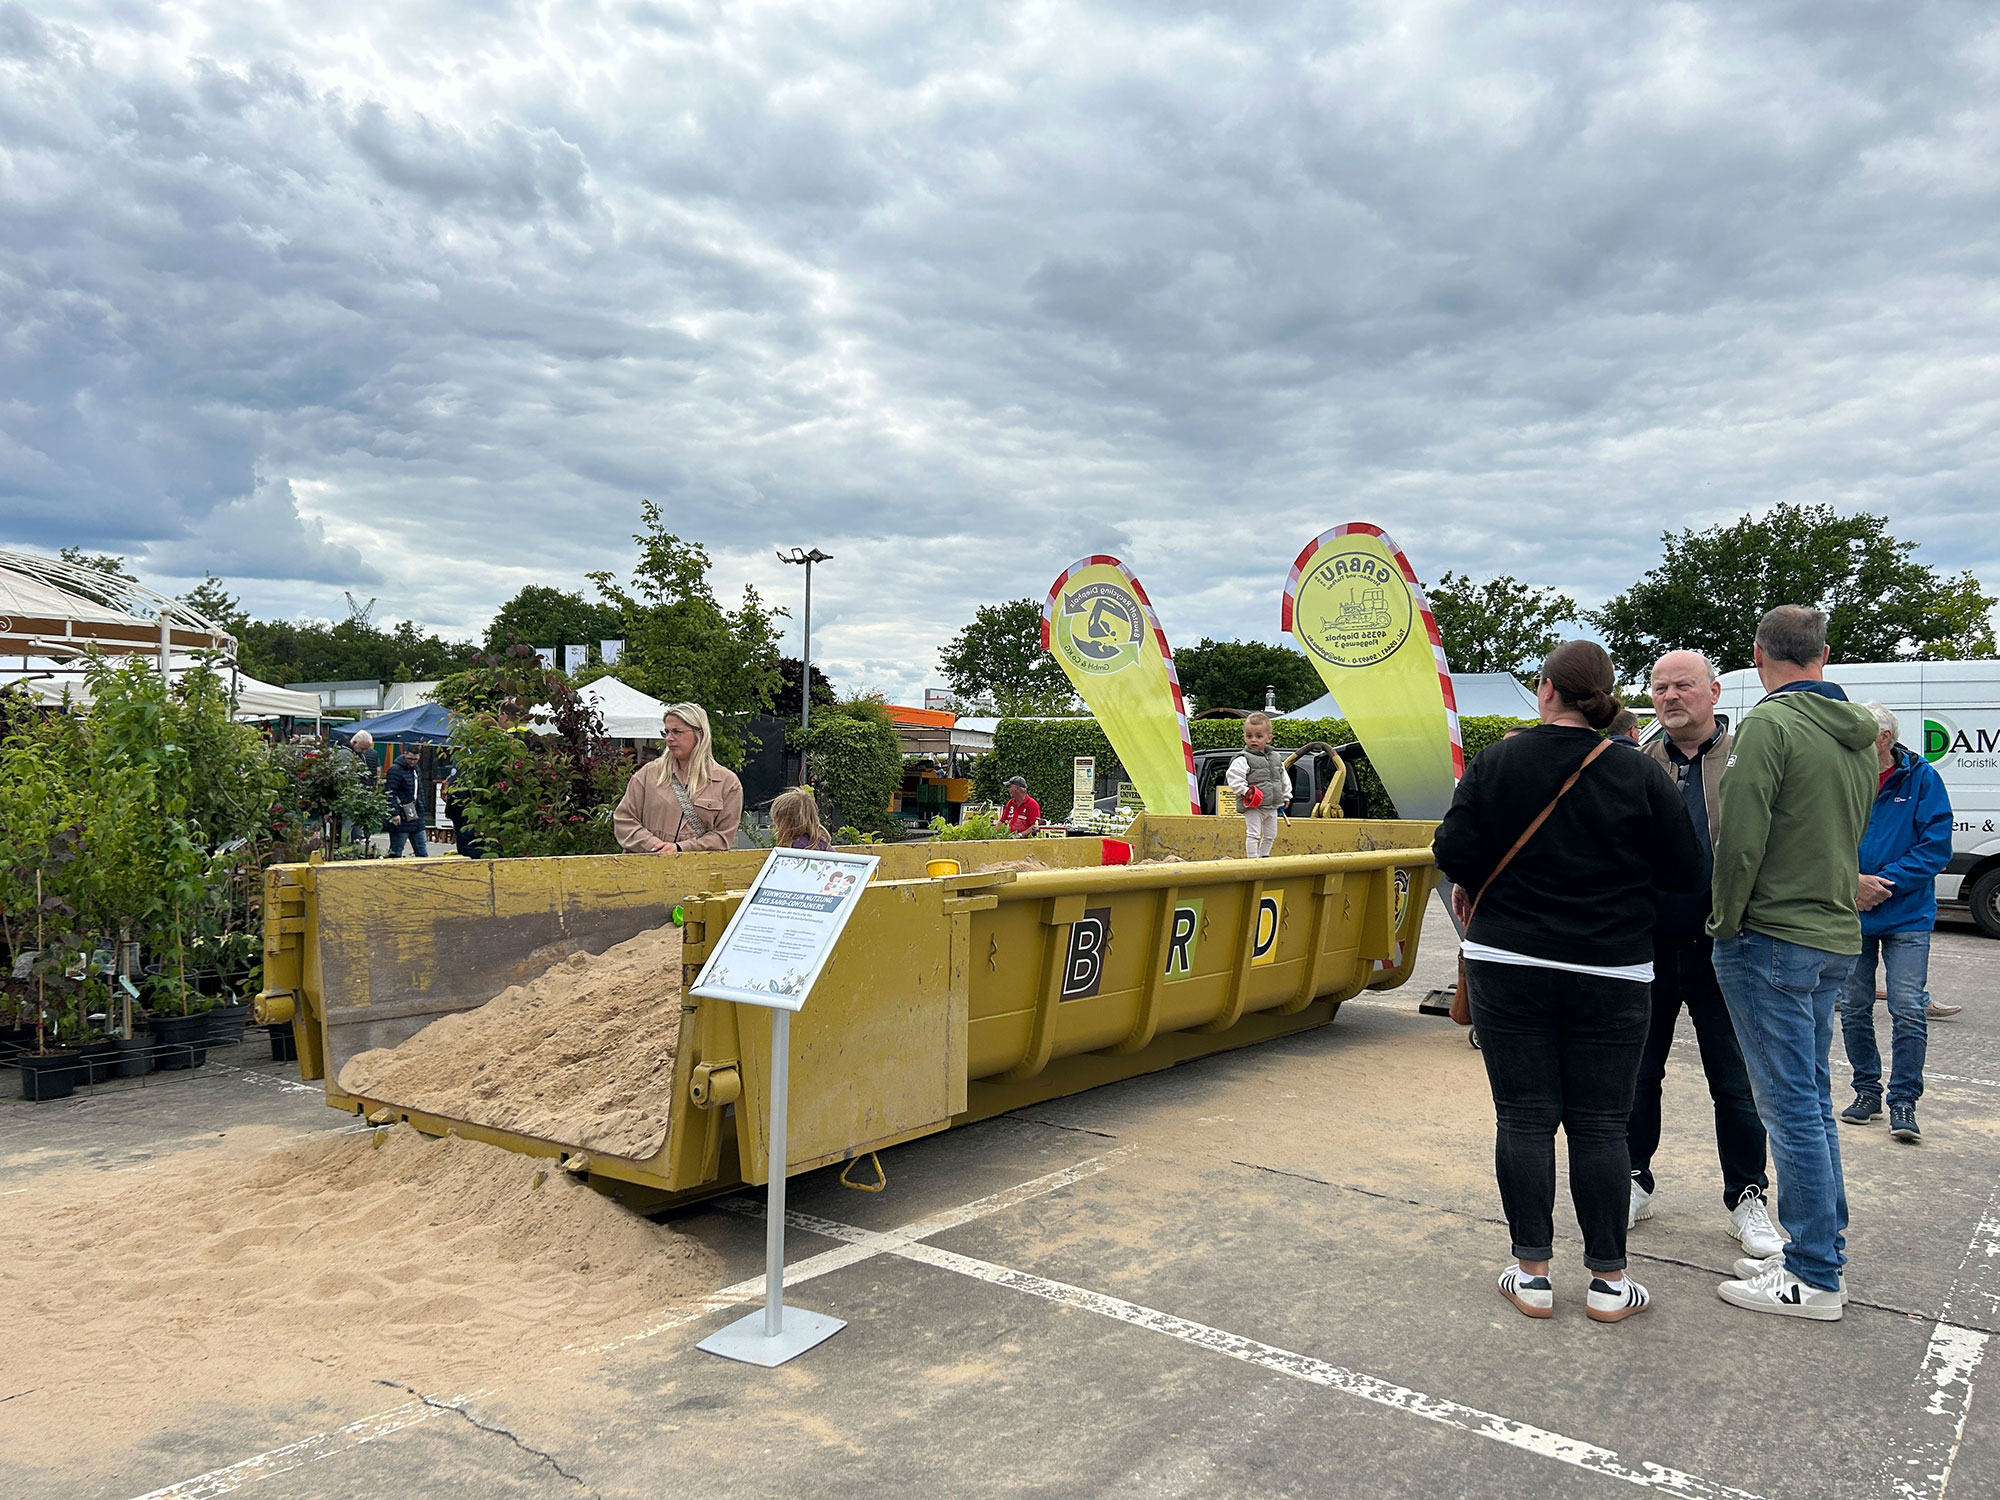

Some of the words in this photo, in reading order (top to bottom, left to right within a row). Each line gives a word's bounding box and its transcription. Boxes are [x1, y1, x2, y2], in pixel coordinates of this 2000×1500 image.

[1957, 758, 1998, 768] floristik
[1982, 818, 1995, 832] &
[761, 889, 793, 899] HINWEISE
[792, 893, 805, 901] ZUR
[804, 894, 834, 904] NUTZUNG
[770, 898, 825, 911] SAND-CONTAINERS
[1063, 917, 1104, 996] B
[1165, 906, 1198, 976] R
[1252, 896, 1279, 959] D
